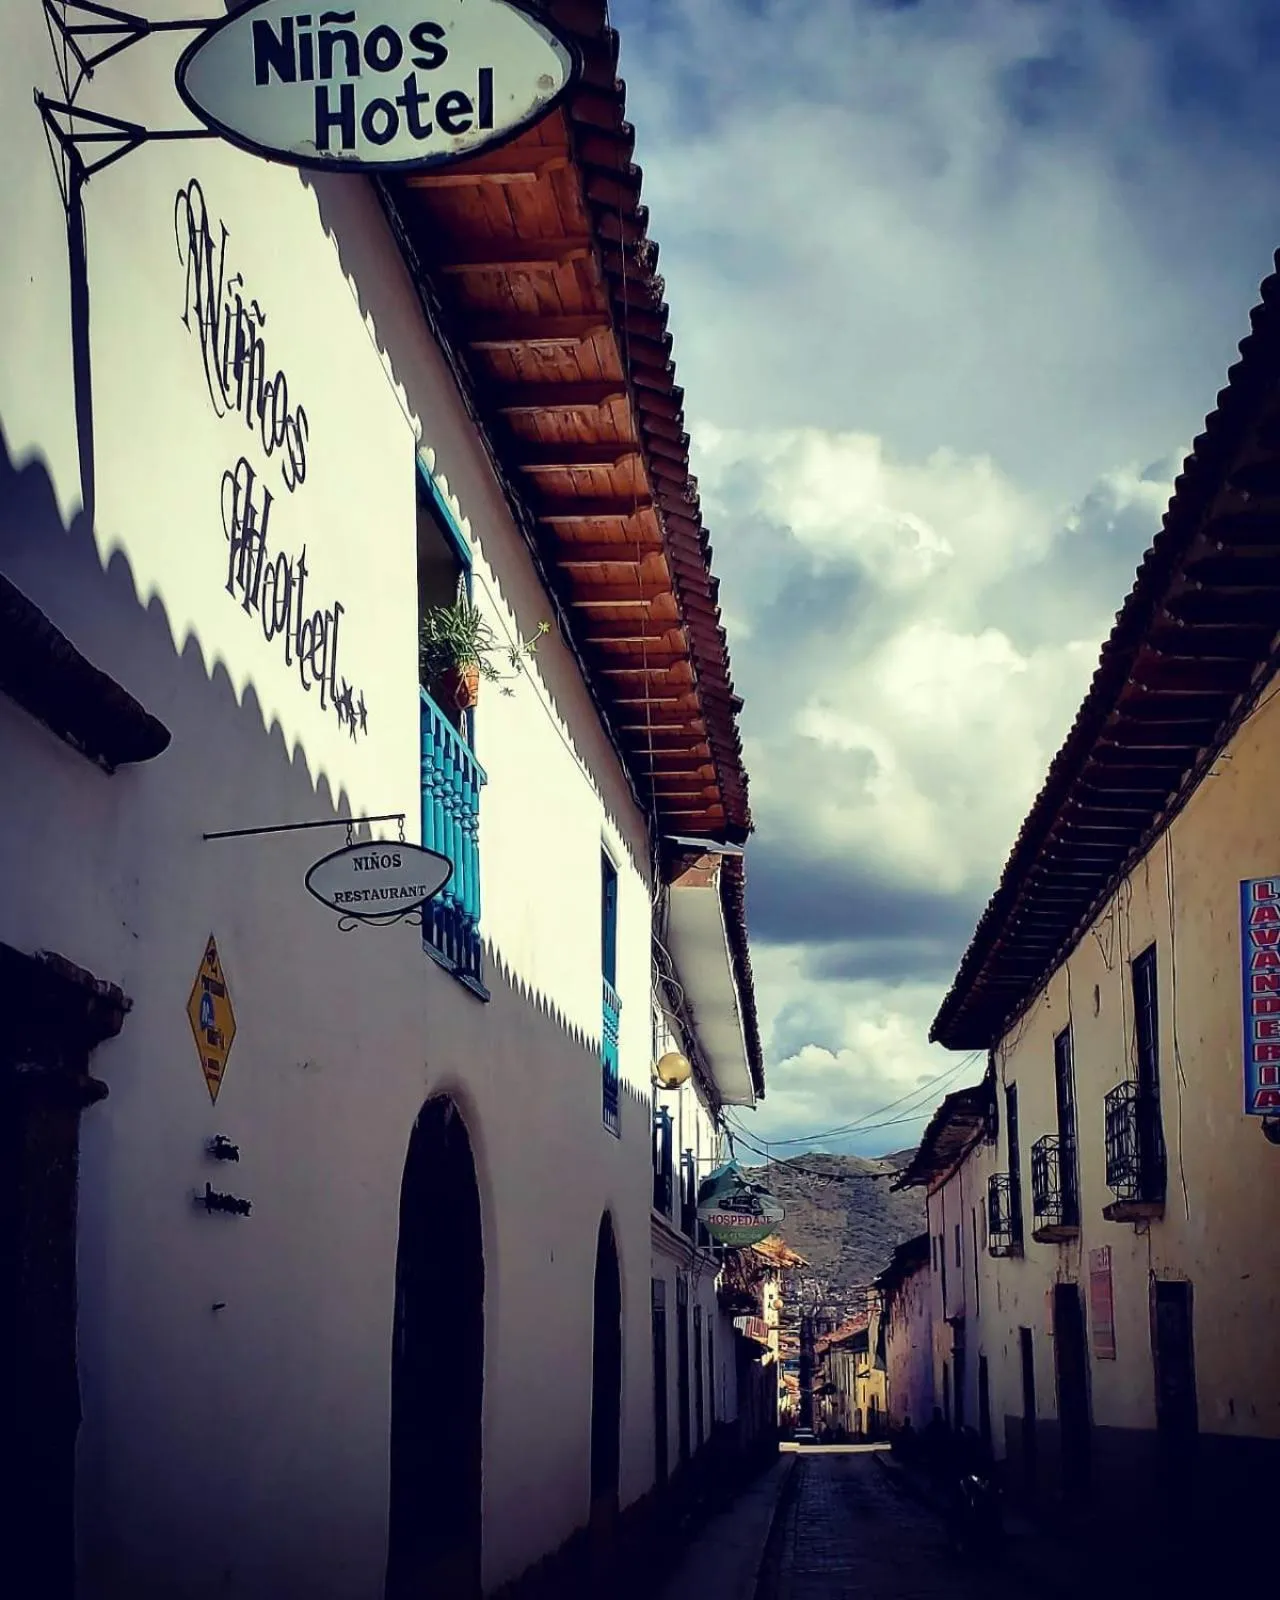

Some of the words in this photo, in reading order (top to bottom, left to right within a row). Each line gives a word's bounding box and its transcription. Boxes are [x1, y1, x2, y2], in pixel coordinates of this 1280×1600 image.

[252, 11, 449, 86] Niños
[314, 67, 494, 150] Hotel
[353, 852, 402, 871] NIÑOS
[334, 885, 427, 904] RESTAURANT
[708, 1214, 773, 1227] HOSPEDAJE
